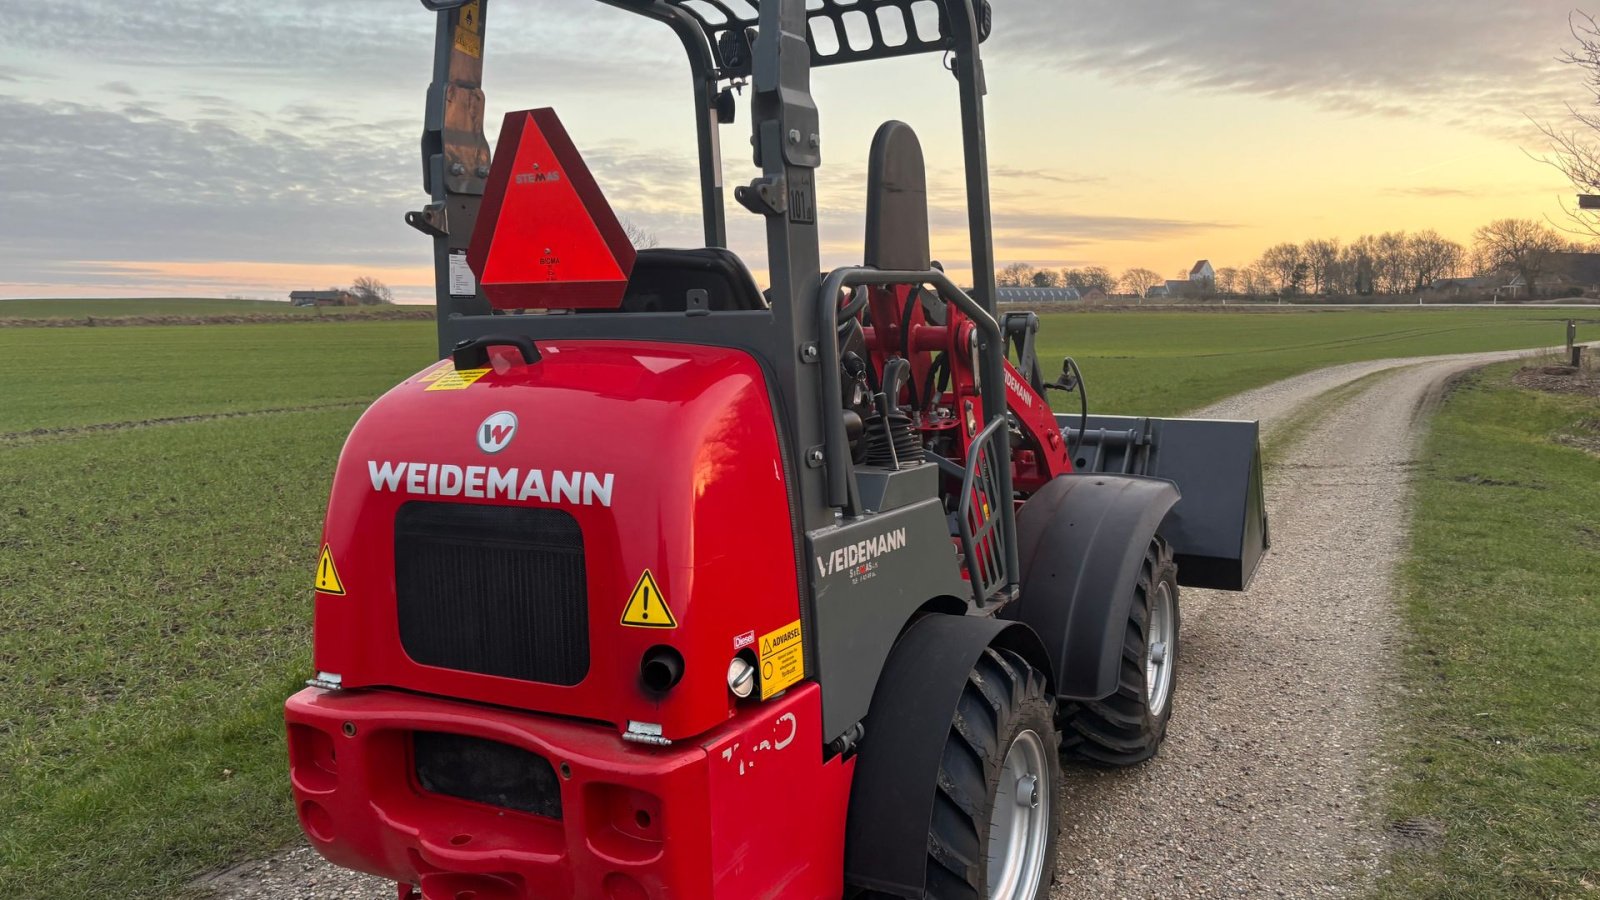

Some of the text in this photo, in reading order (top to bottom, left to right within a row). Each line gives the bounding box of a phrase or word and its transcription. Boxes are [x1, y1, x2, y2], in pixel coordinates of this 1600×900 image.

[515, 170, 560, 184] STEMAS
[367, 460, 615, 507] WEIDEMANN
[735, 634, 753, 647] Diesel
[772, 628, 801, 648] ADVARSEL
